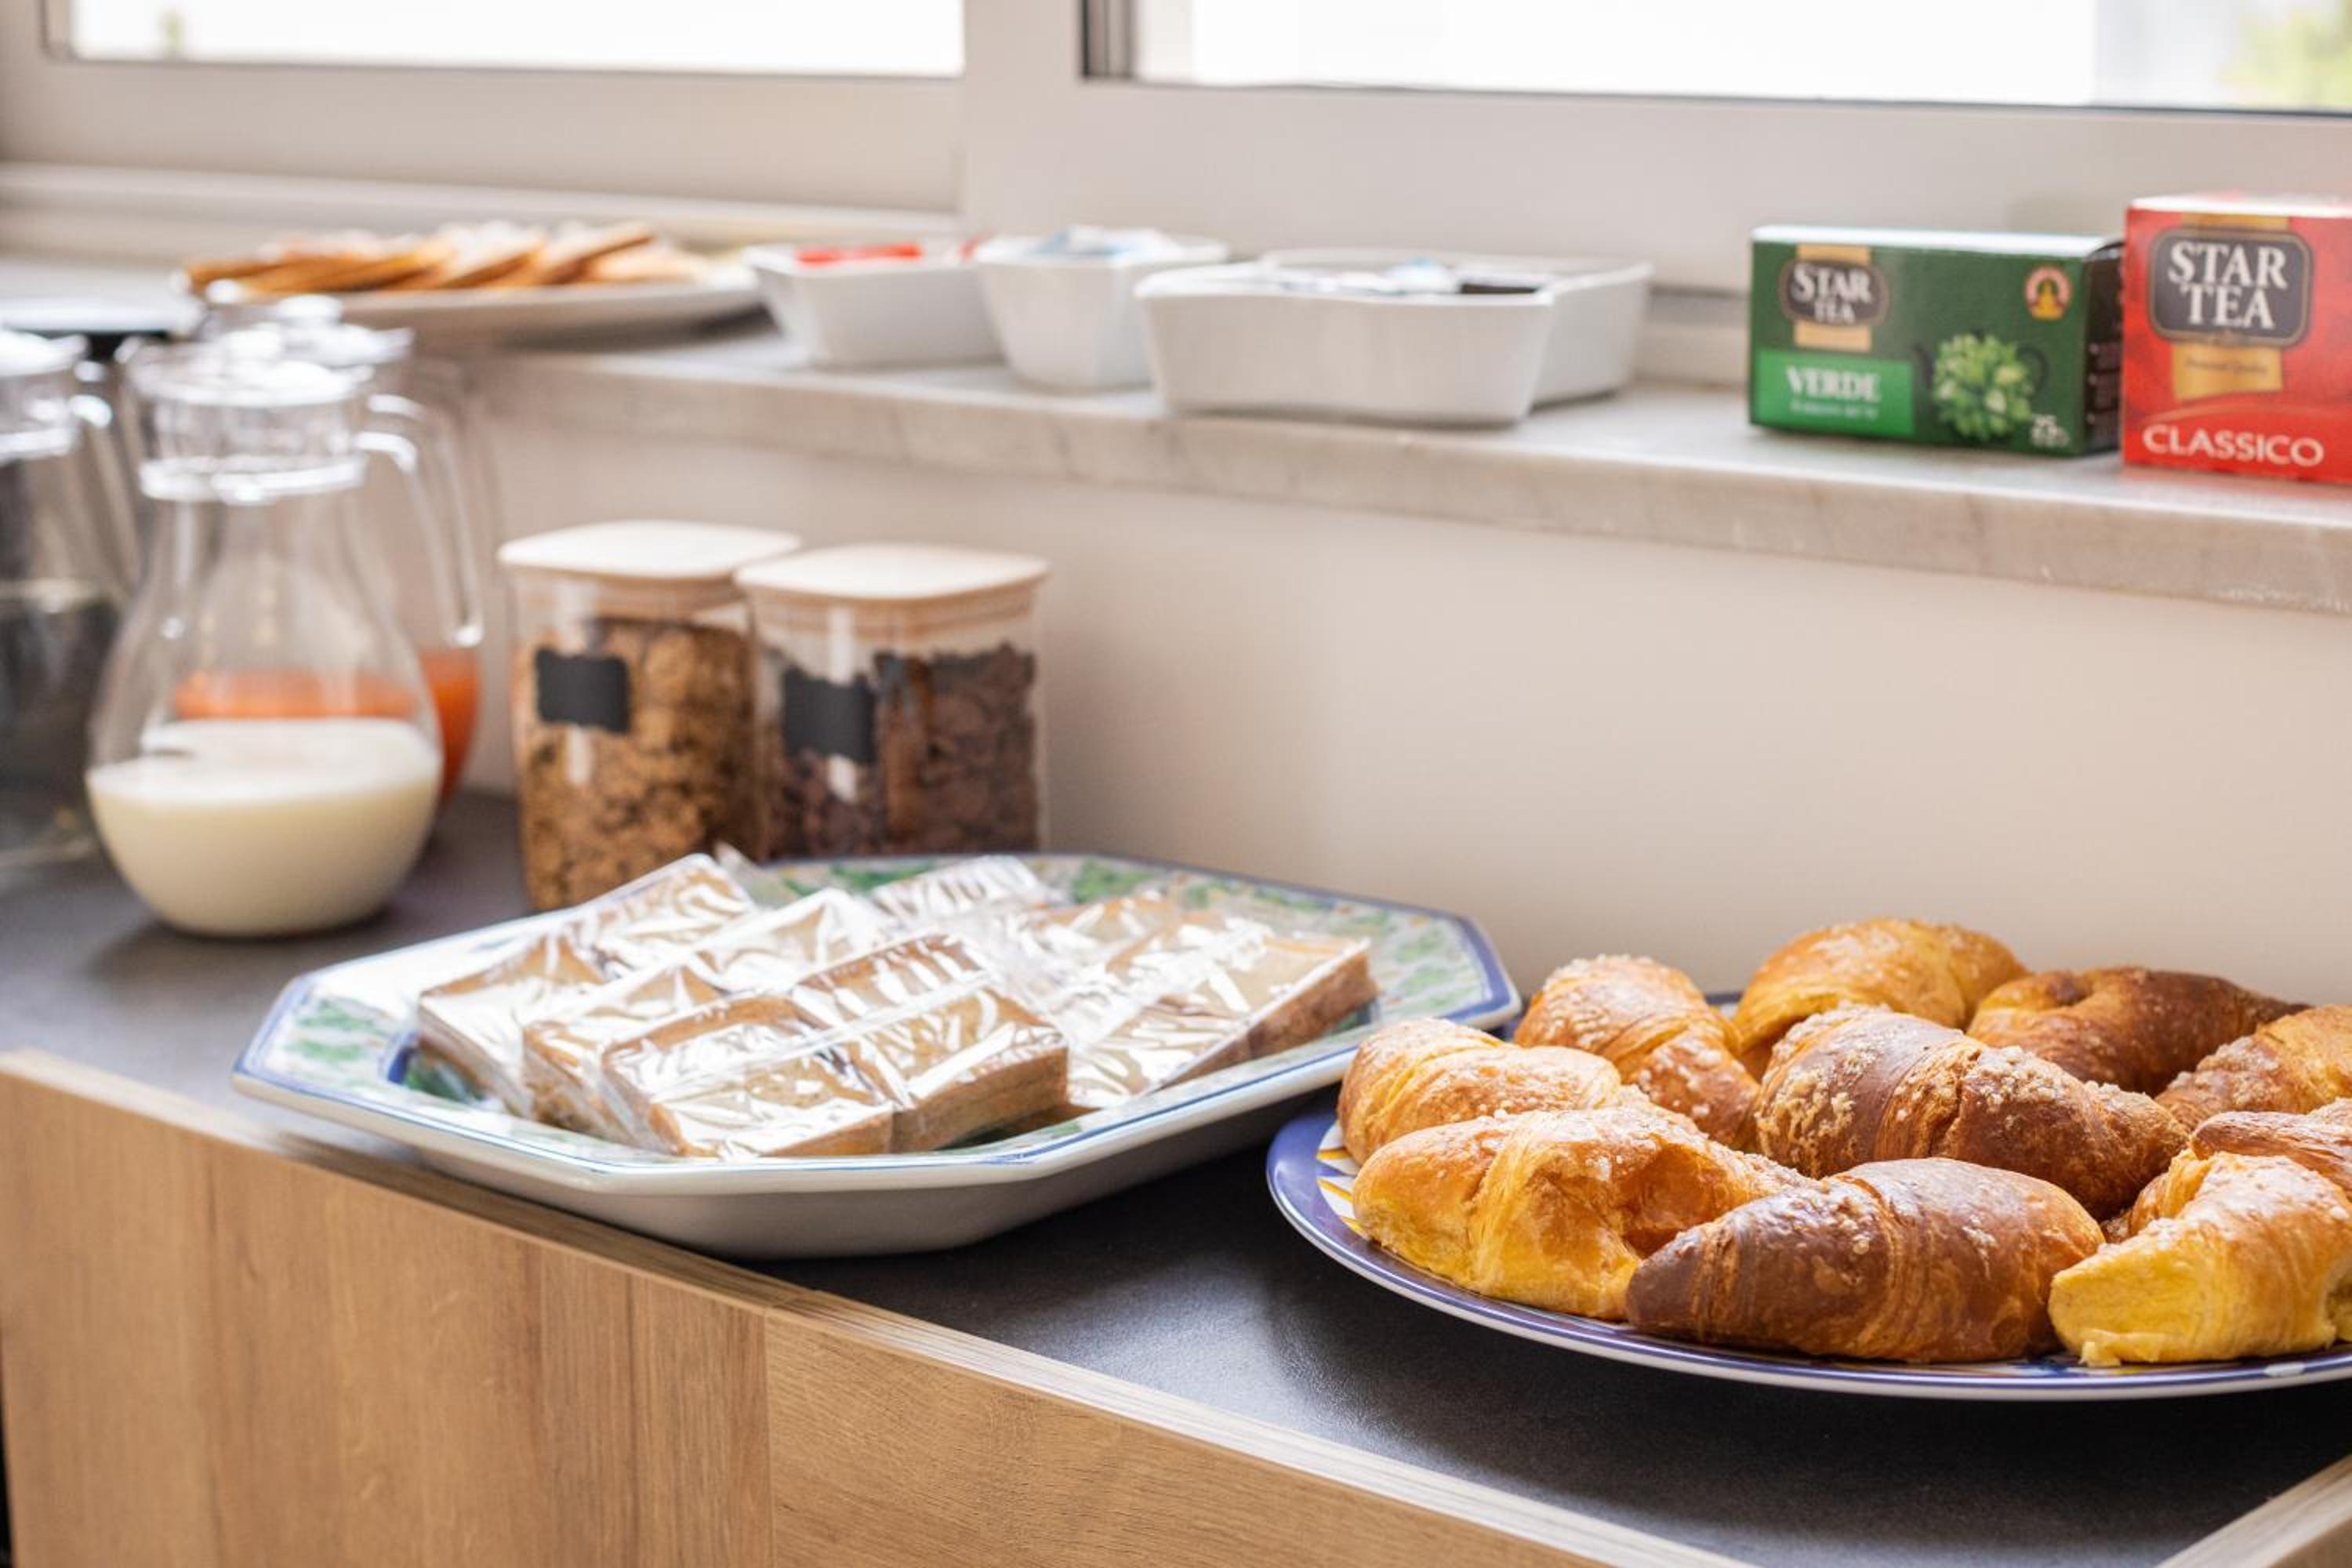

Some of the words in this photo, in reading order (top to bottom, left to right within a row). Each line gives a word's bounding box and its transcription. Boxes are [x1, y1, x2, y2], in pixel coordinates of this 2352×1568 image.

[1791, 264, 1871, 302] STAR
[2168, 241, 2287, 289] STAR
[1814, 300, 1855, 325] TEA
[2179, 283, 2274, 328] TEA
[1787, 366, 1881, 401] VERDE
[2142, 424, 2325, 467] CLASSICO
